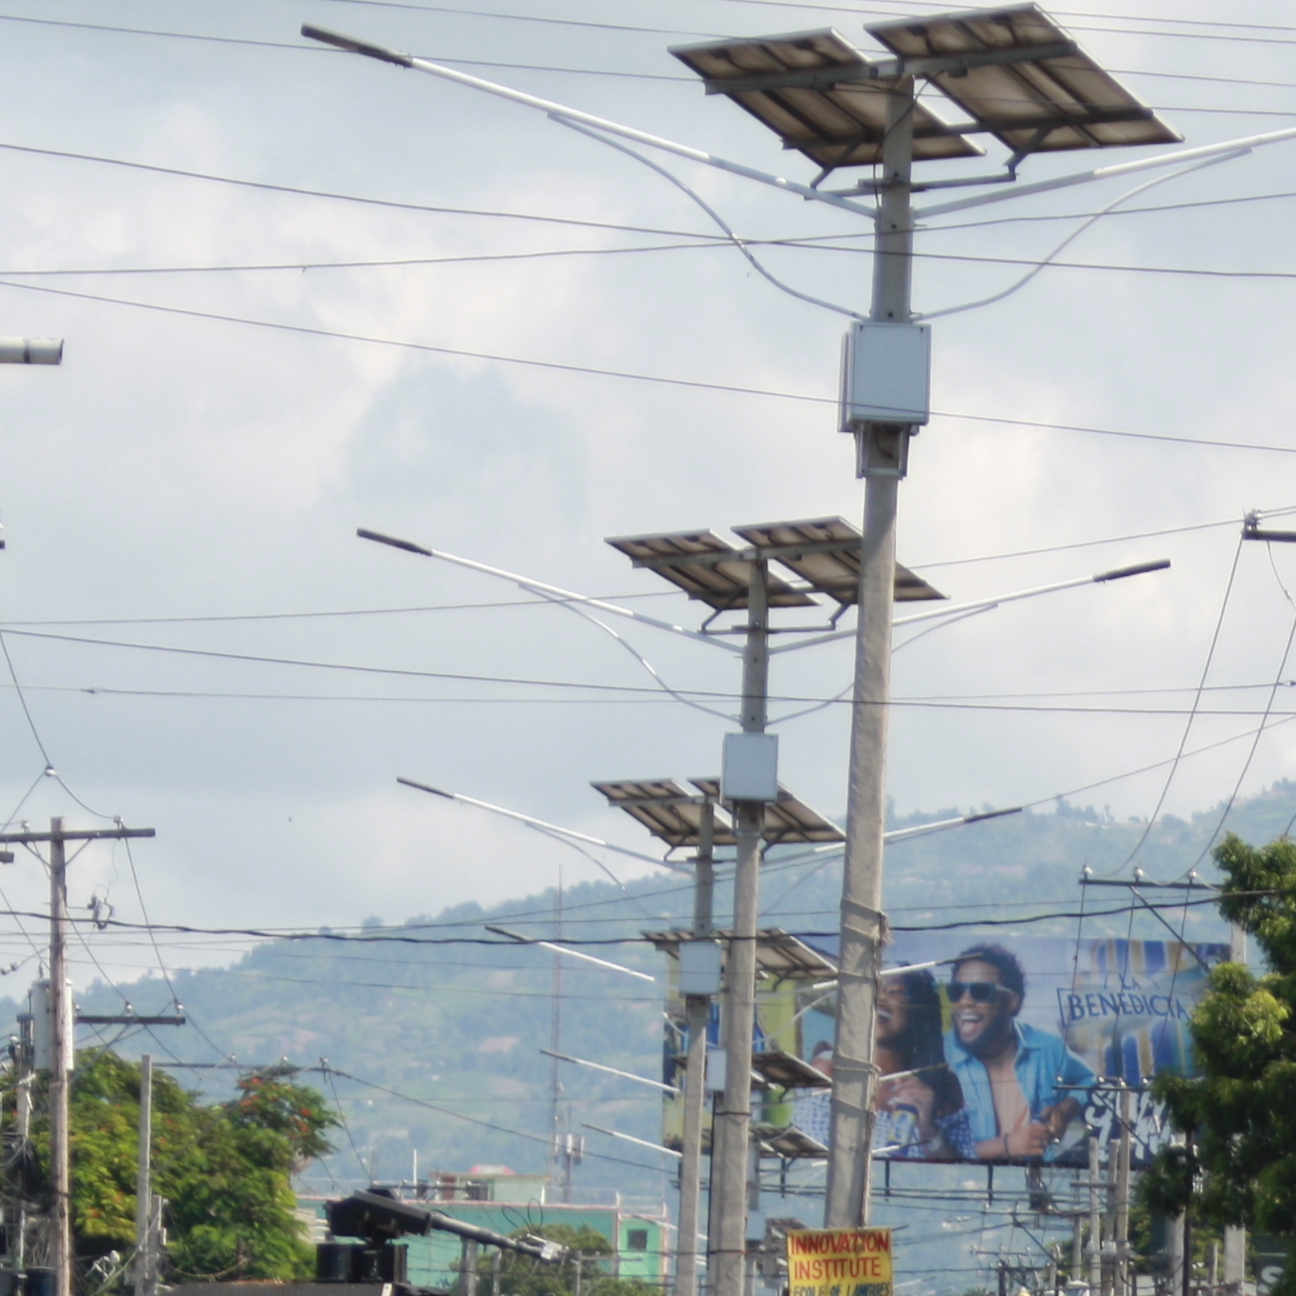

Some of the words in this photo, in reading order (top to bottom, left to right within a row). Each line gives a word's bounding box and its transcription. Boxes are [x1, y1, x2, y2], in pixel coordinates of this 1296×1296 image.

[1067, 992, 1191, 1022] BENEDICTA
[792, 1232, 890, 1254] INNOVATION
[794, 1257, 881, 1280] INSTITUTE
